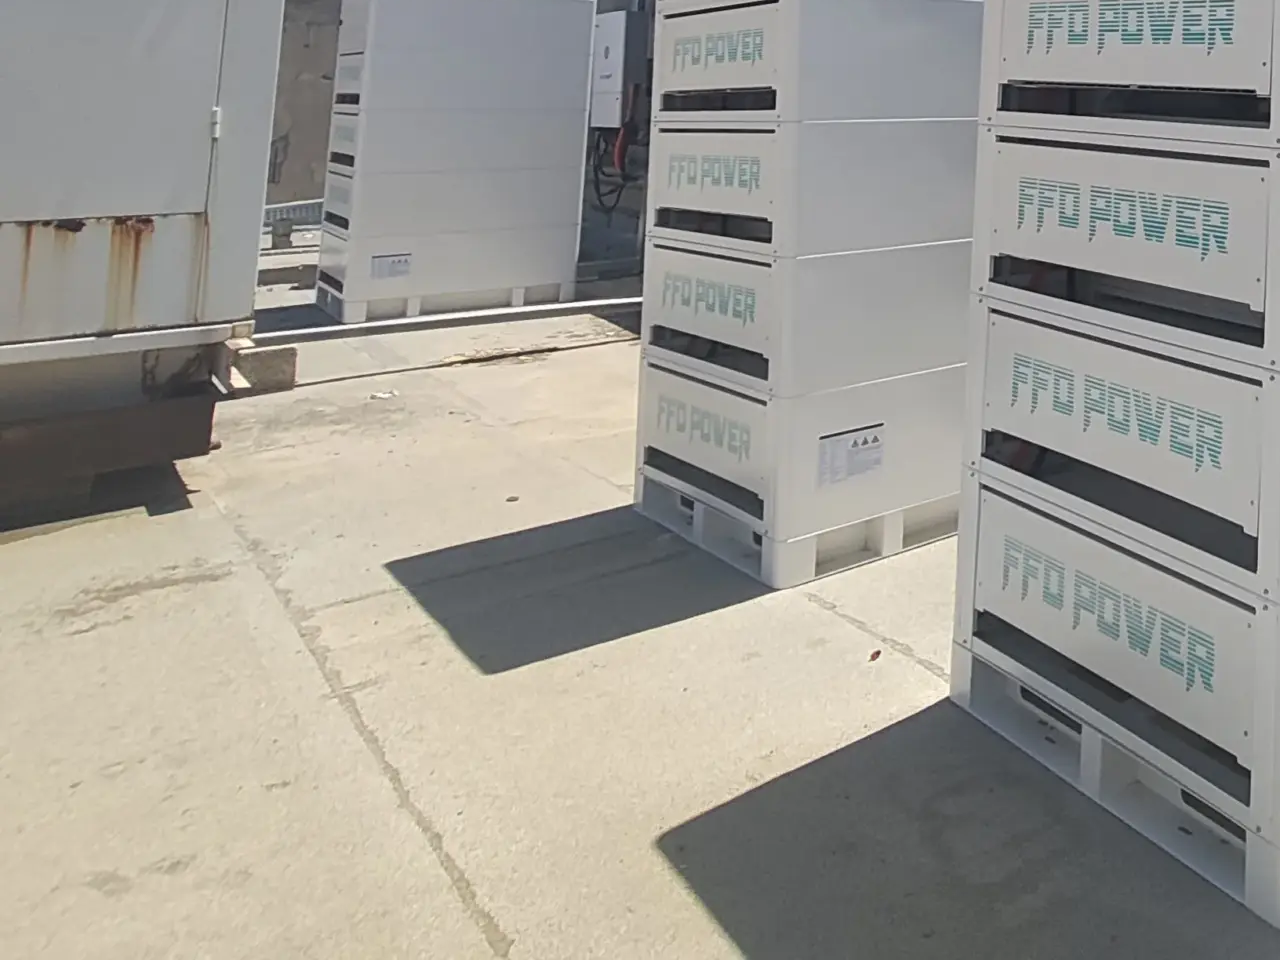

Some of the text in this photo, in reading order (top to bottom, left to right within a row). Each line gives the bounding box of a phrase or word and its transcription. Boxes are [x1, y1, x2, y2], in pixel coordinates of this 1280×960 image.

[704, 28, 764, 70] POWER
[701, 155, 760, 195] POWER
[1088, 185, 1229, 261] POWER
[695, 277, 755, 328] POWER
[689, 404, 751, 463] POWER
[1083, 374, 1223, 473] POWER
[1073, 569, 1215, 693] POWER
